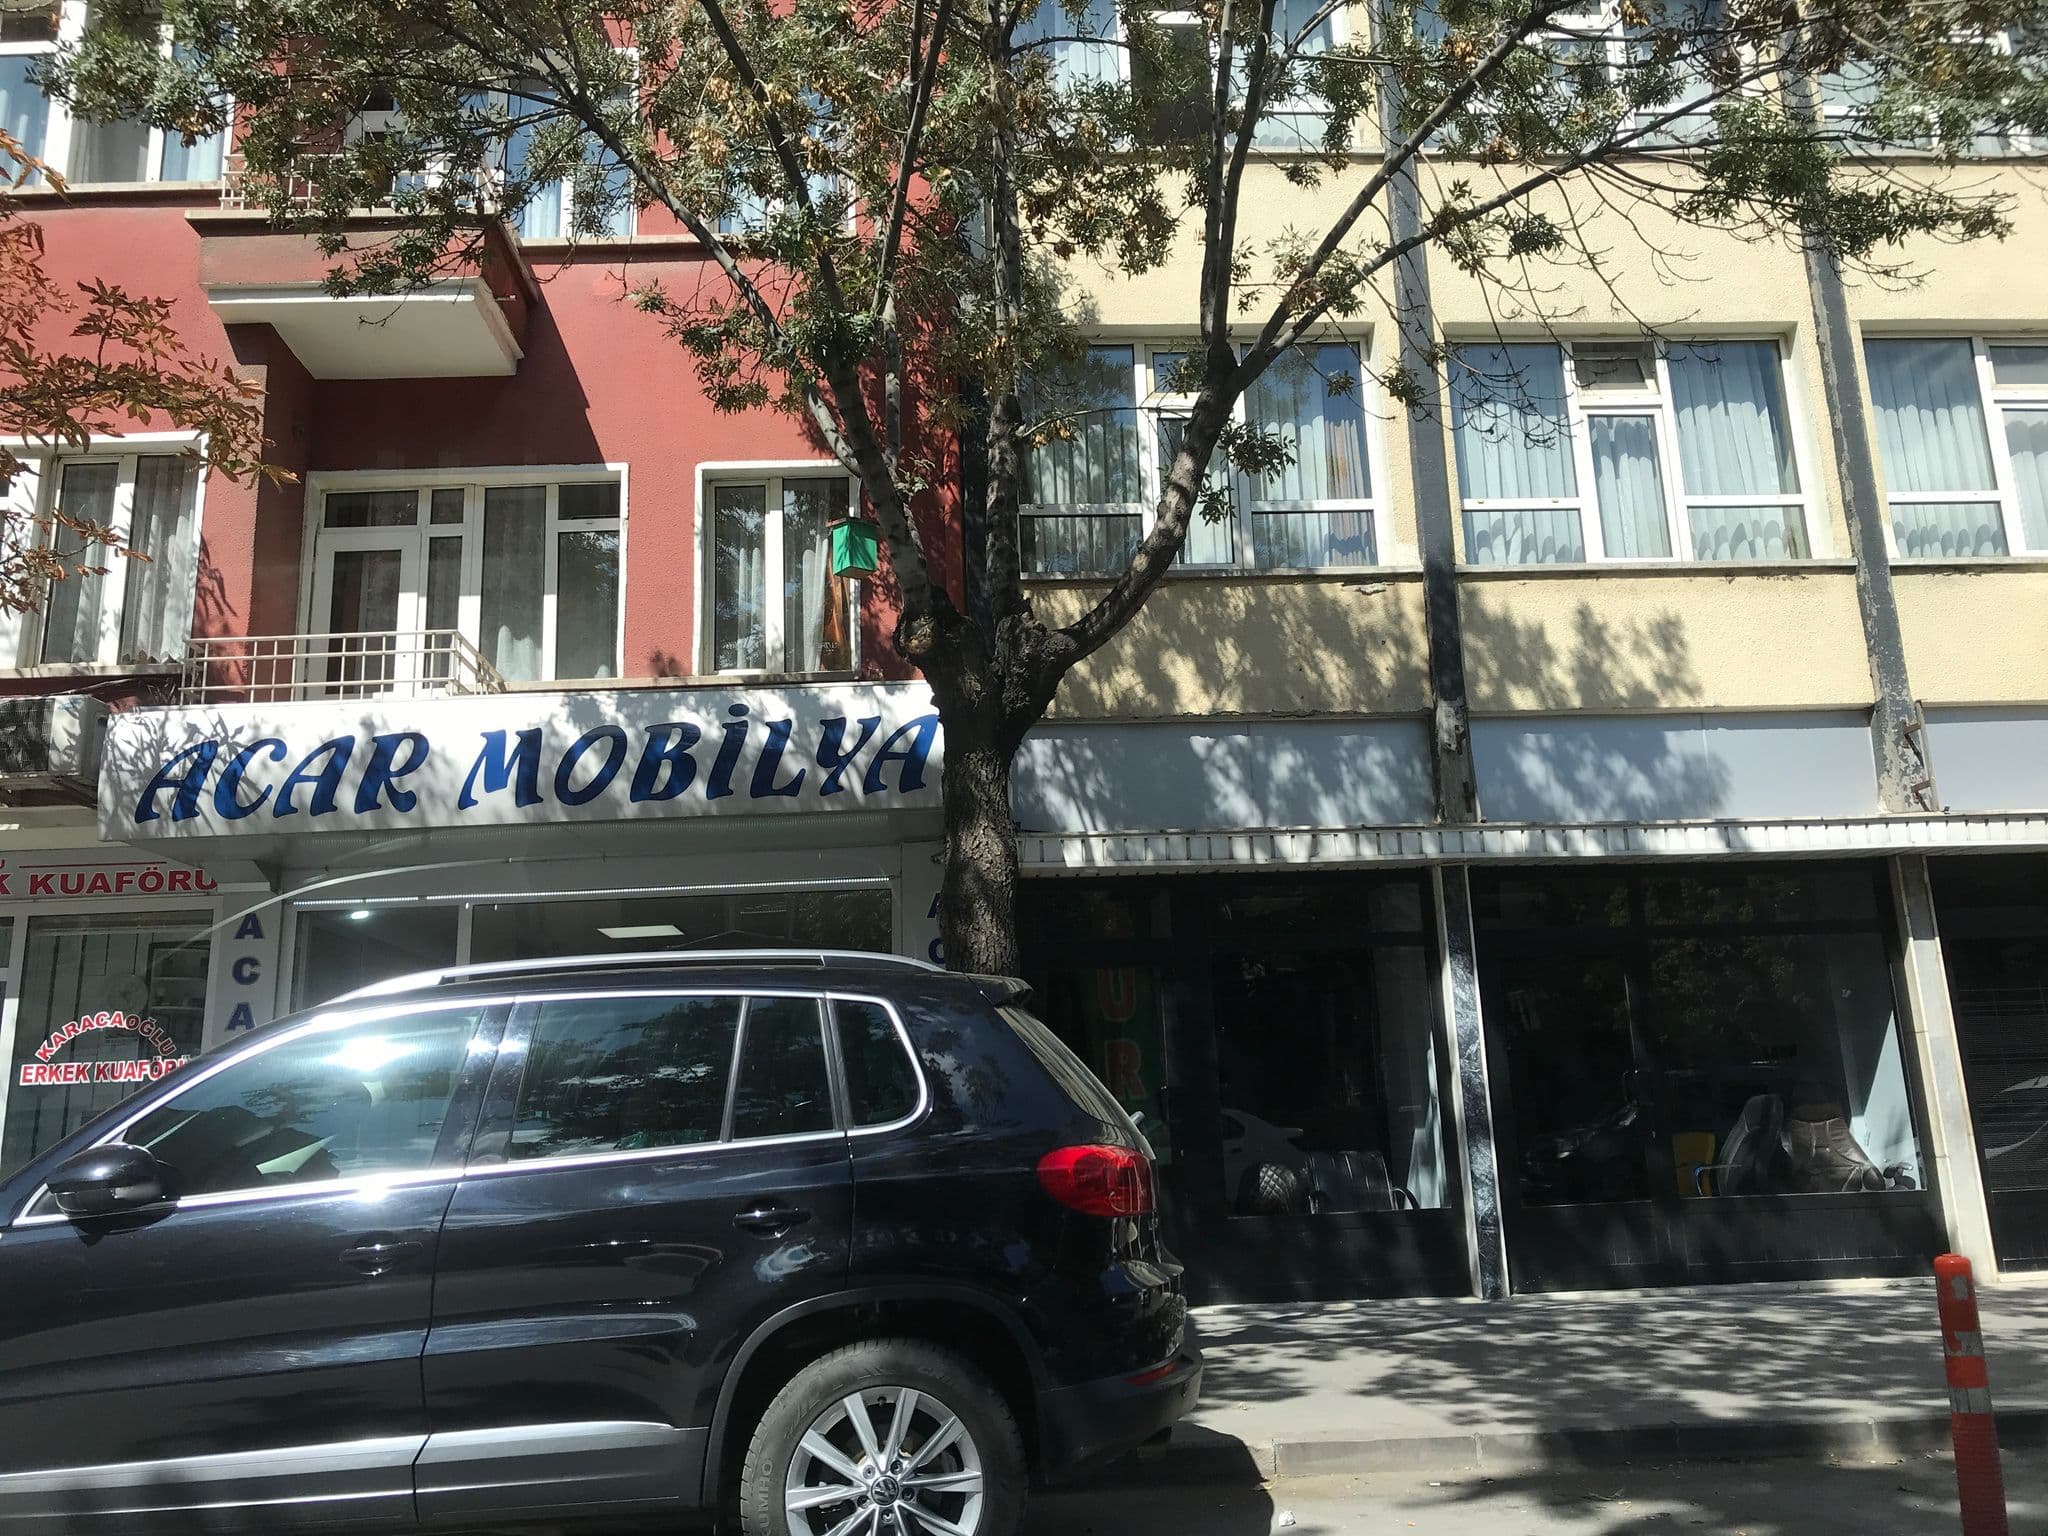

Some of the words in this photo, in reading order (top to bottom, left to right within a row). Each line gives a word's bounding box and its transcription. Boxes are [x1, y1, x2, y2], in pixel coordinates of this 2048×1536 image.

[135, 732, 429, 823] ACAR
[457, 703, 940, 810] MOBİLYA
[35, 1011, 177, 1062] KARACAOĞLU
[20, 1062, 91, 1085] ERKEK
